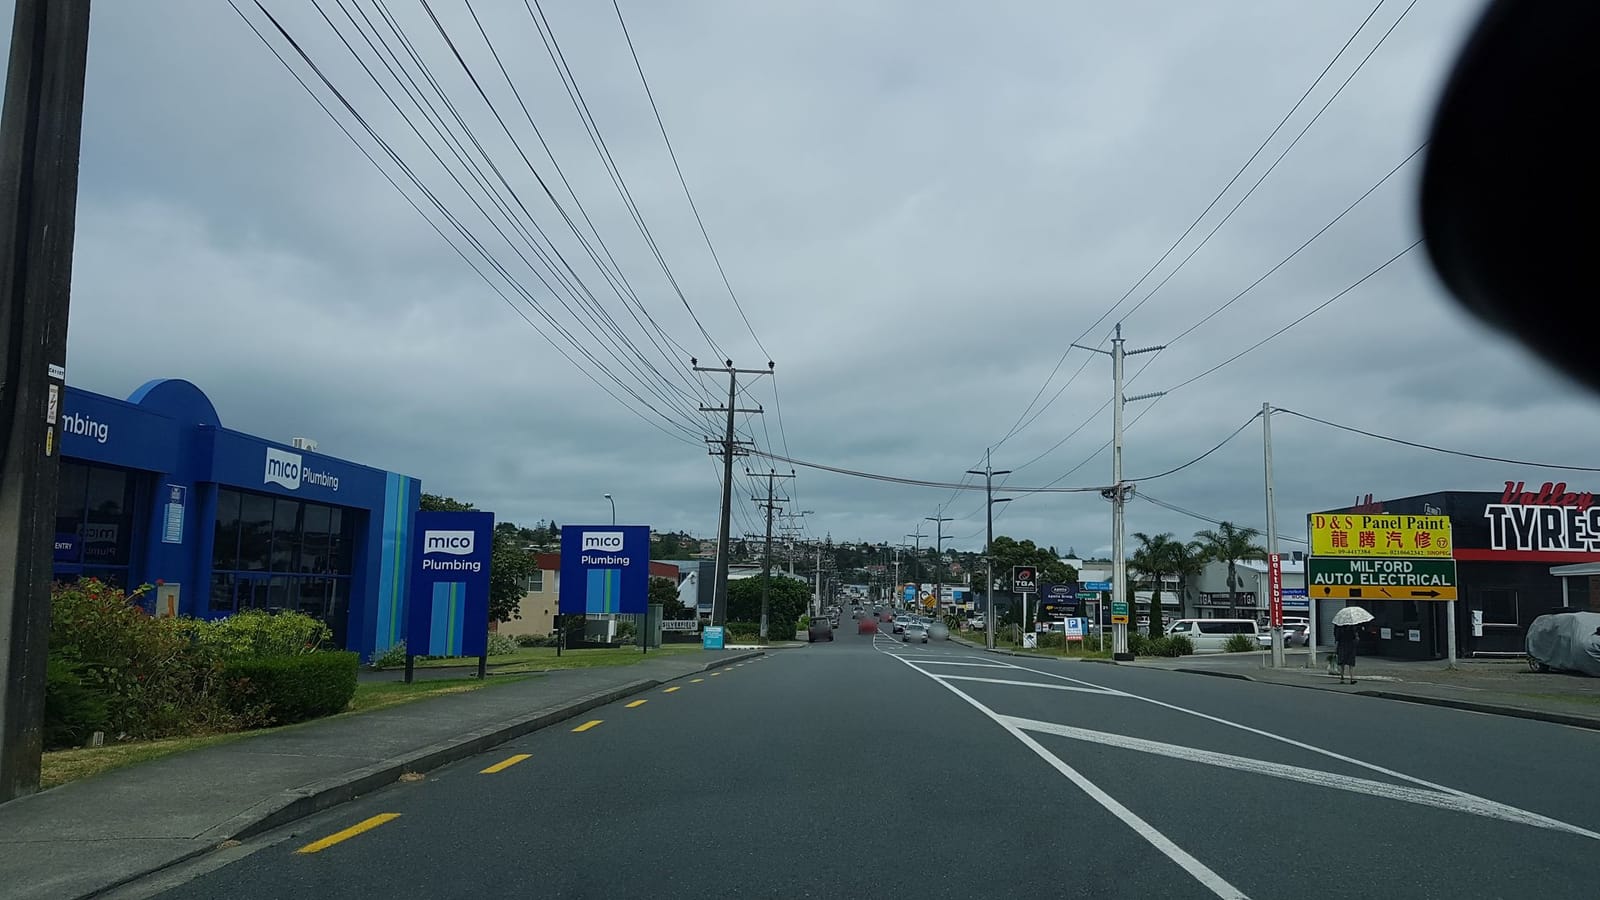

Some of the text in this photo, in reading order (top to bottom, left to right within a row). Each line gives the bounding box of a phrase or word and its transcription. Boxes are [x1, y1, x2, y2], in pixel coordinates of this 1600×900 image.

[268, 459, 339, 491] mico Plumbing
[1501, 481, 1594, 512] Valley
[1315, 516, 1444, 530] D & S Panel Paint
[54, 542, 72, 550] ENTRY
[429, 537, 470, 548] mico
[586, 537, 620, 547] mico
[423, 559, 480, 572] Plumbing
[581, 555, 630, 566] Plumbing
[1350, 561, 1413, 573] MILFORD
[1315, 573, 1451, 586] AUTO ELECTRICAL
